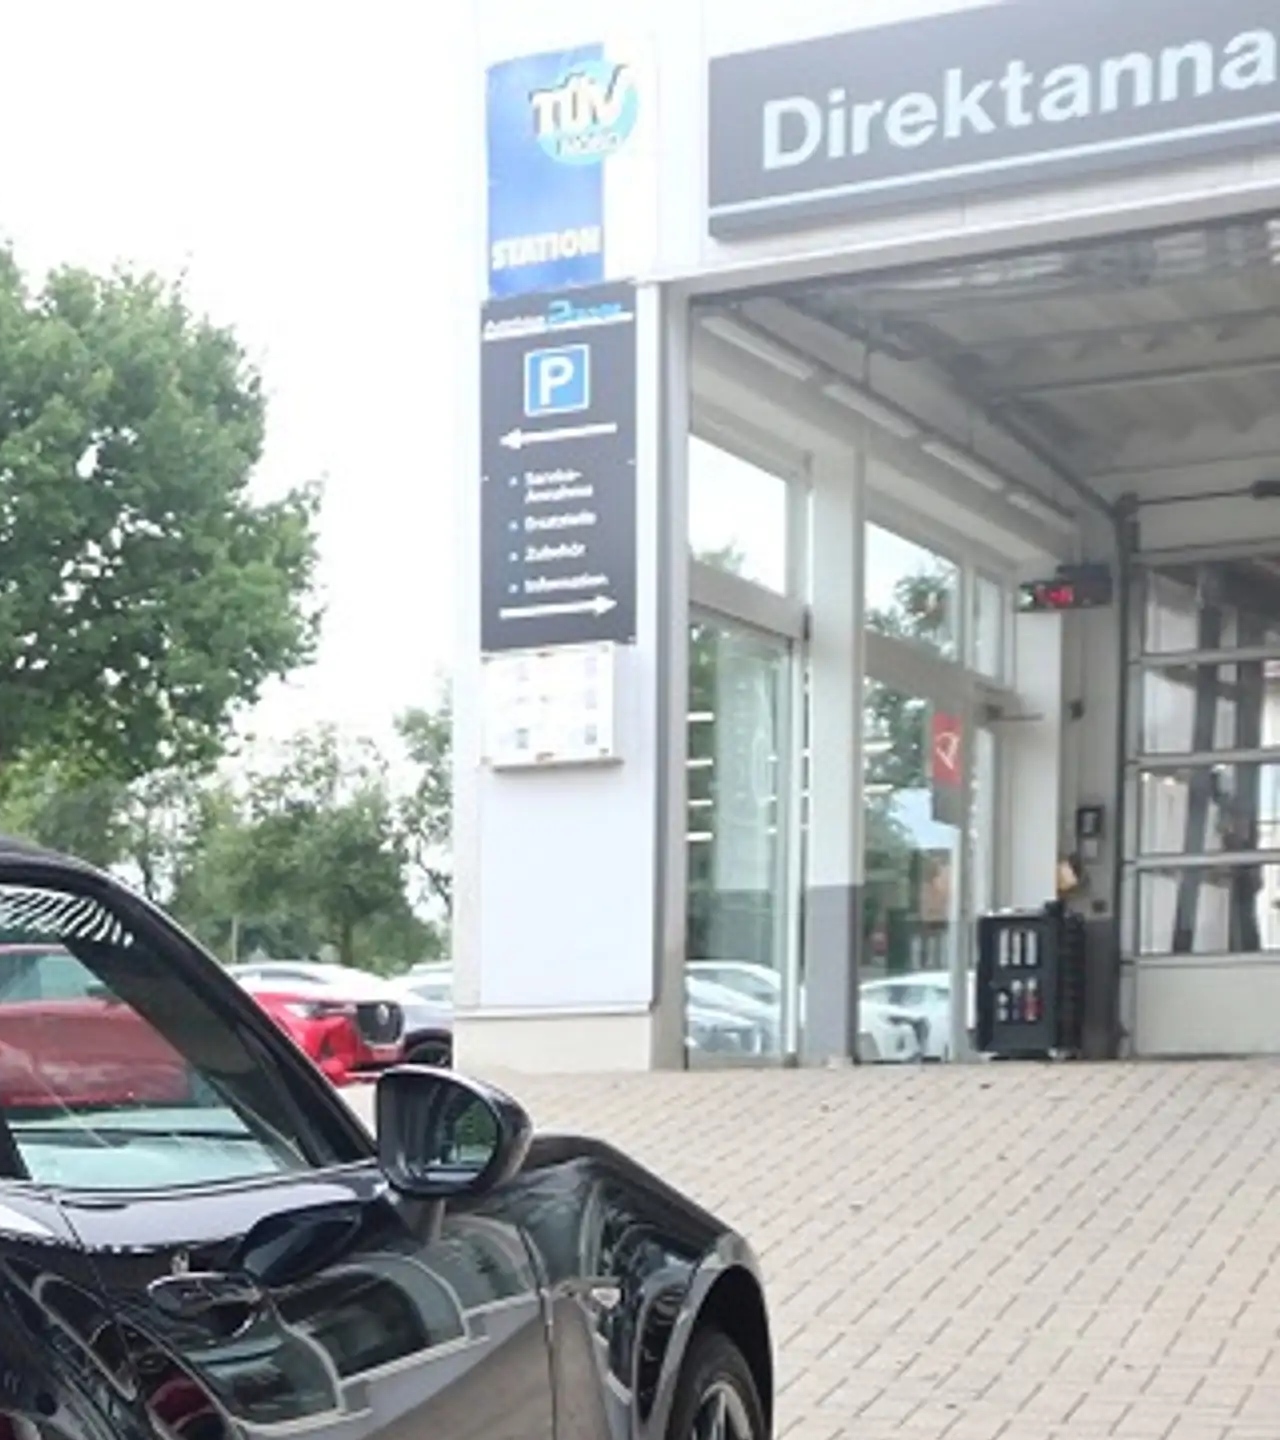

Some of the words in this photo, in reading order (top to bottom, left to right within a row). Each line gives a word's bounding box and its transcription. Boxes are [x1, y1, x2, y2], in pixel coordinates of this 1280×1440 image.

[531, 64, 630, 136] TÜV
[763, 28, 1278, 170] Direktanna
[491, 226, 602, 270] STATION
[540, 356, 574, 406] P
